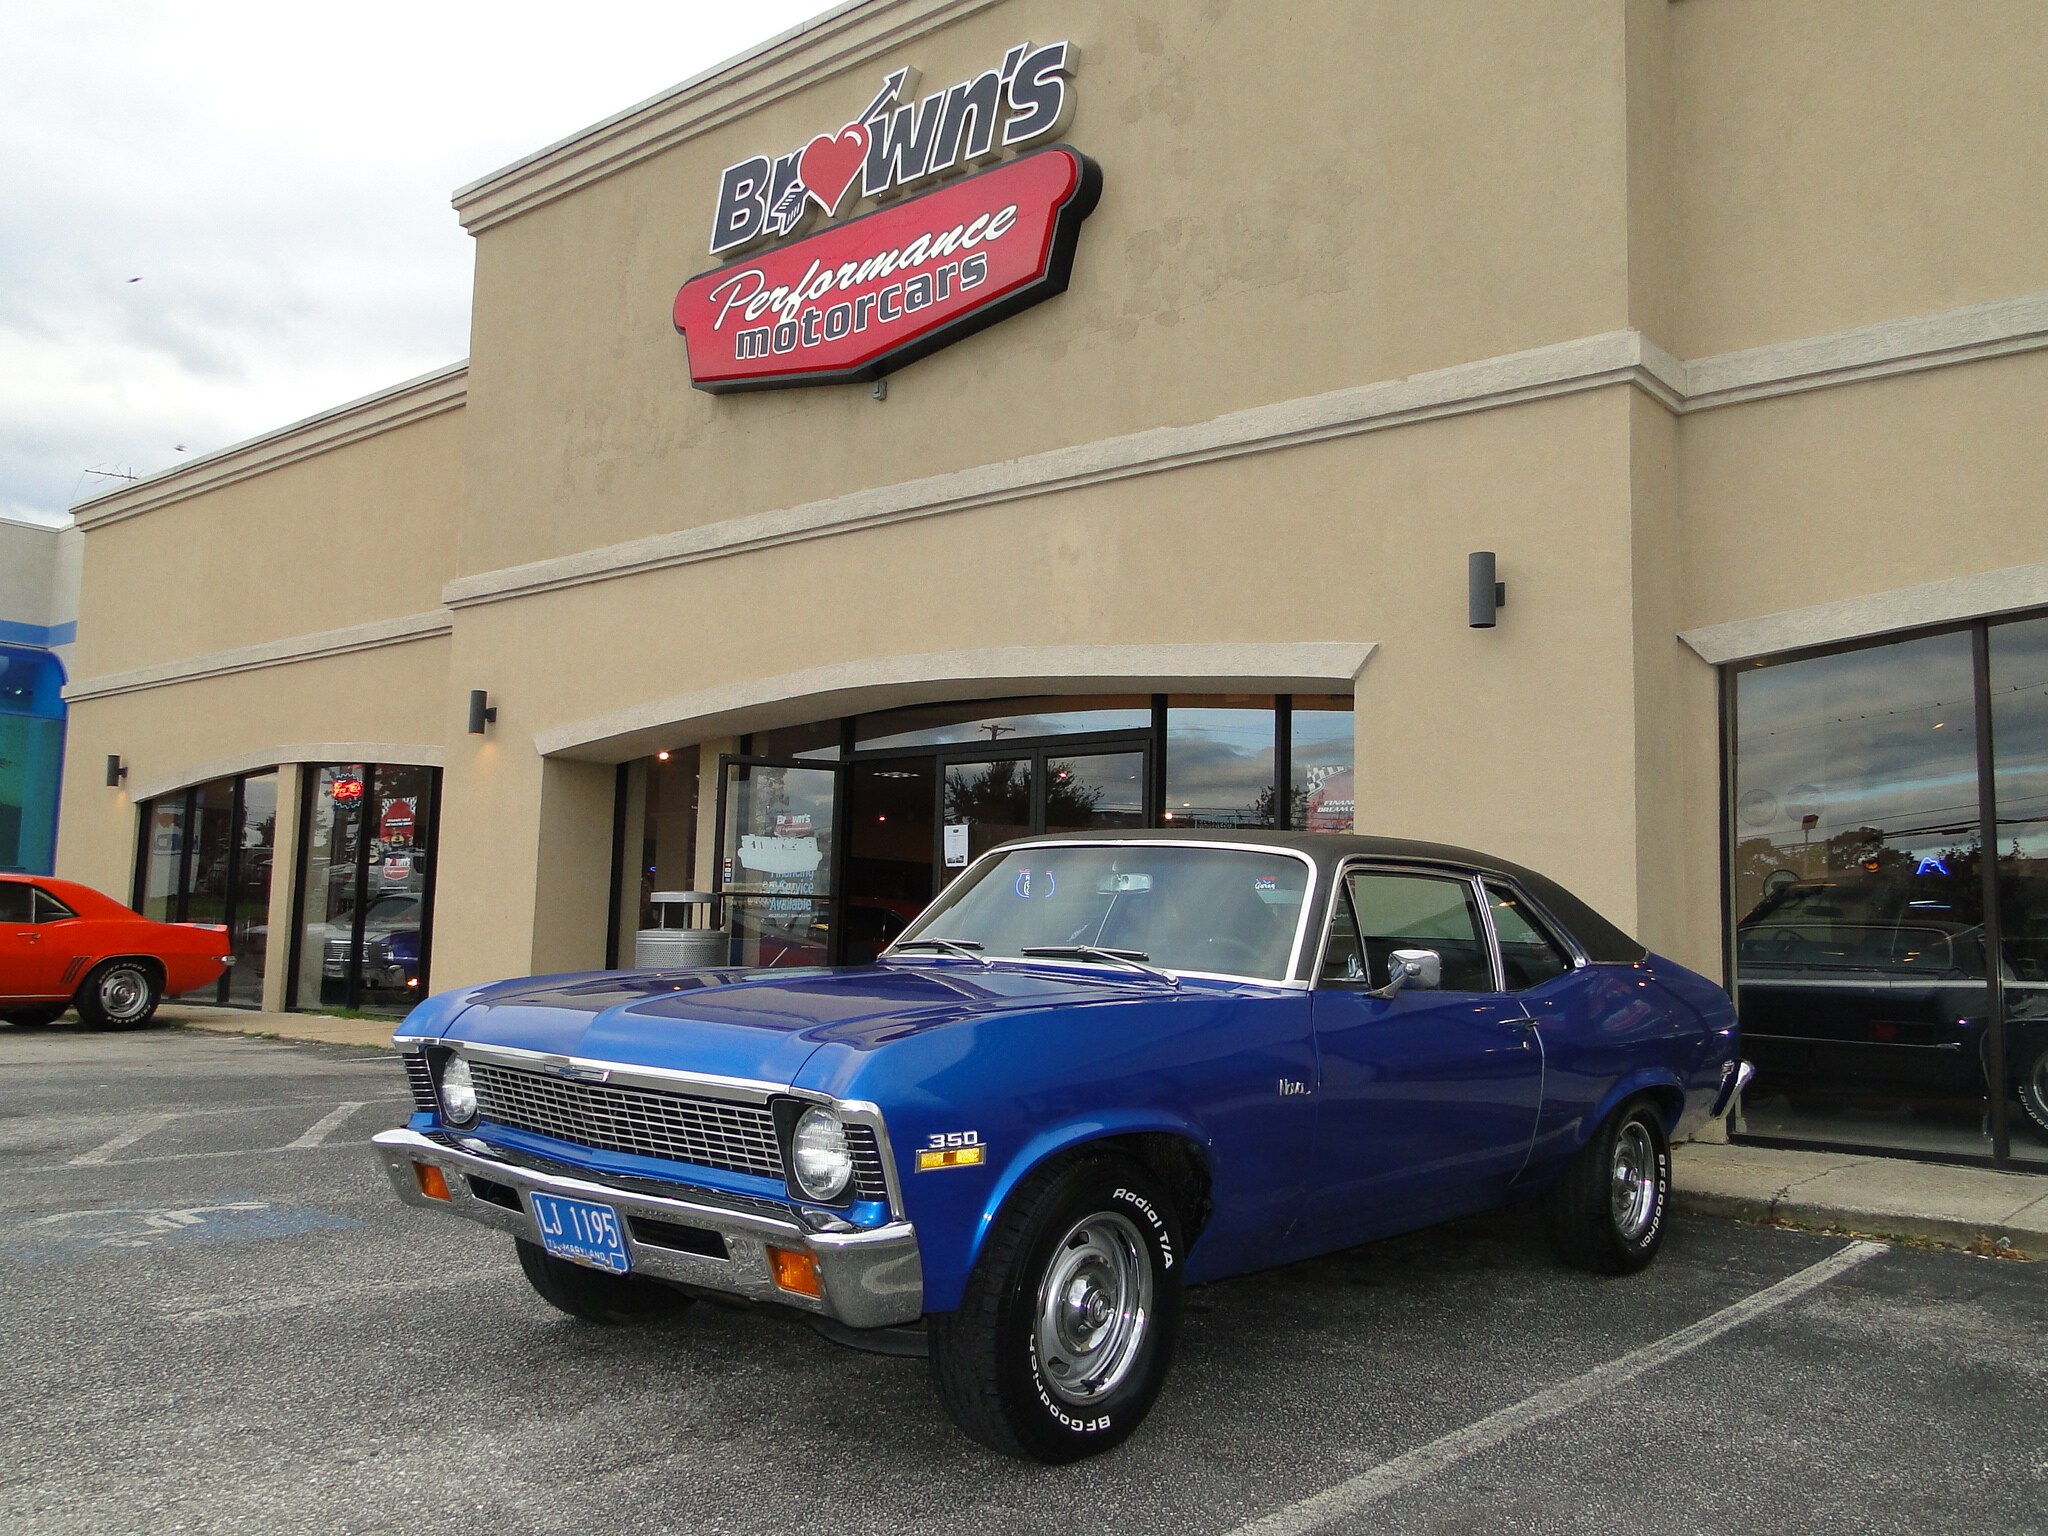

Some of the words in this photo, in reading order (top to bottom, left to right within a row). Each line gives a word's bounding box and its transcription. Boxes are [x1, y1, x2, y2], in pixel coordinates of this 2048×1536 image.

[710, 204, 1018, 331] Performance
[735, 251, 988, 360] motorcars
[769, 896, 812, 911] Available
[928, 1129, 978, 1149] 350
[534, 1199, 563, 1236] LJ
[569, 1206, 618, 1249] 1195
[561, 1242, 606, 1261] MARYLAND
[1112, 1187, 1163, 1229] Radial
[1159, 1230, 1174, 1270] T/A
[1029, 1333, 1111, 1432] BFGoodrich
